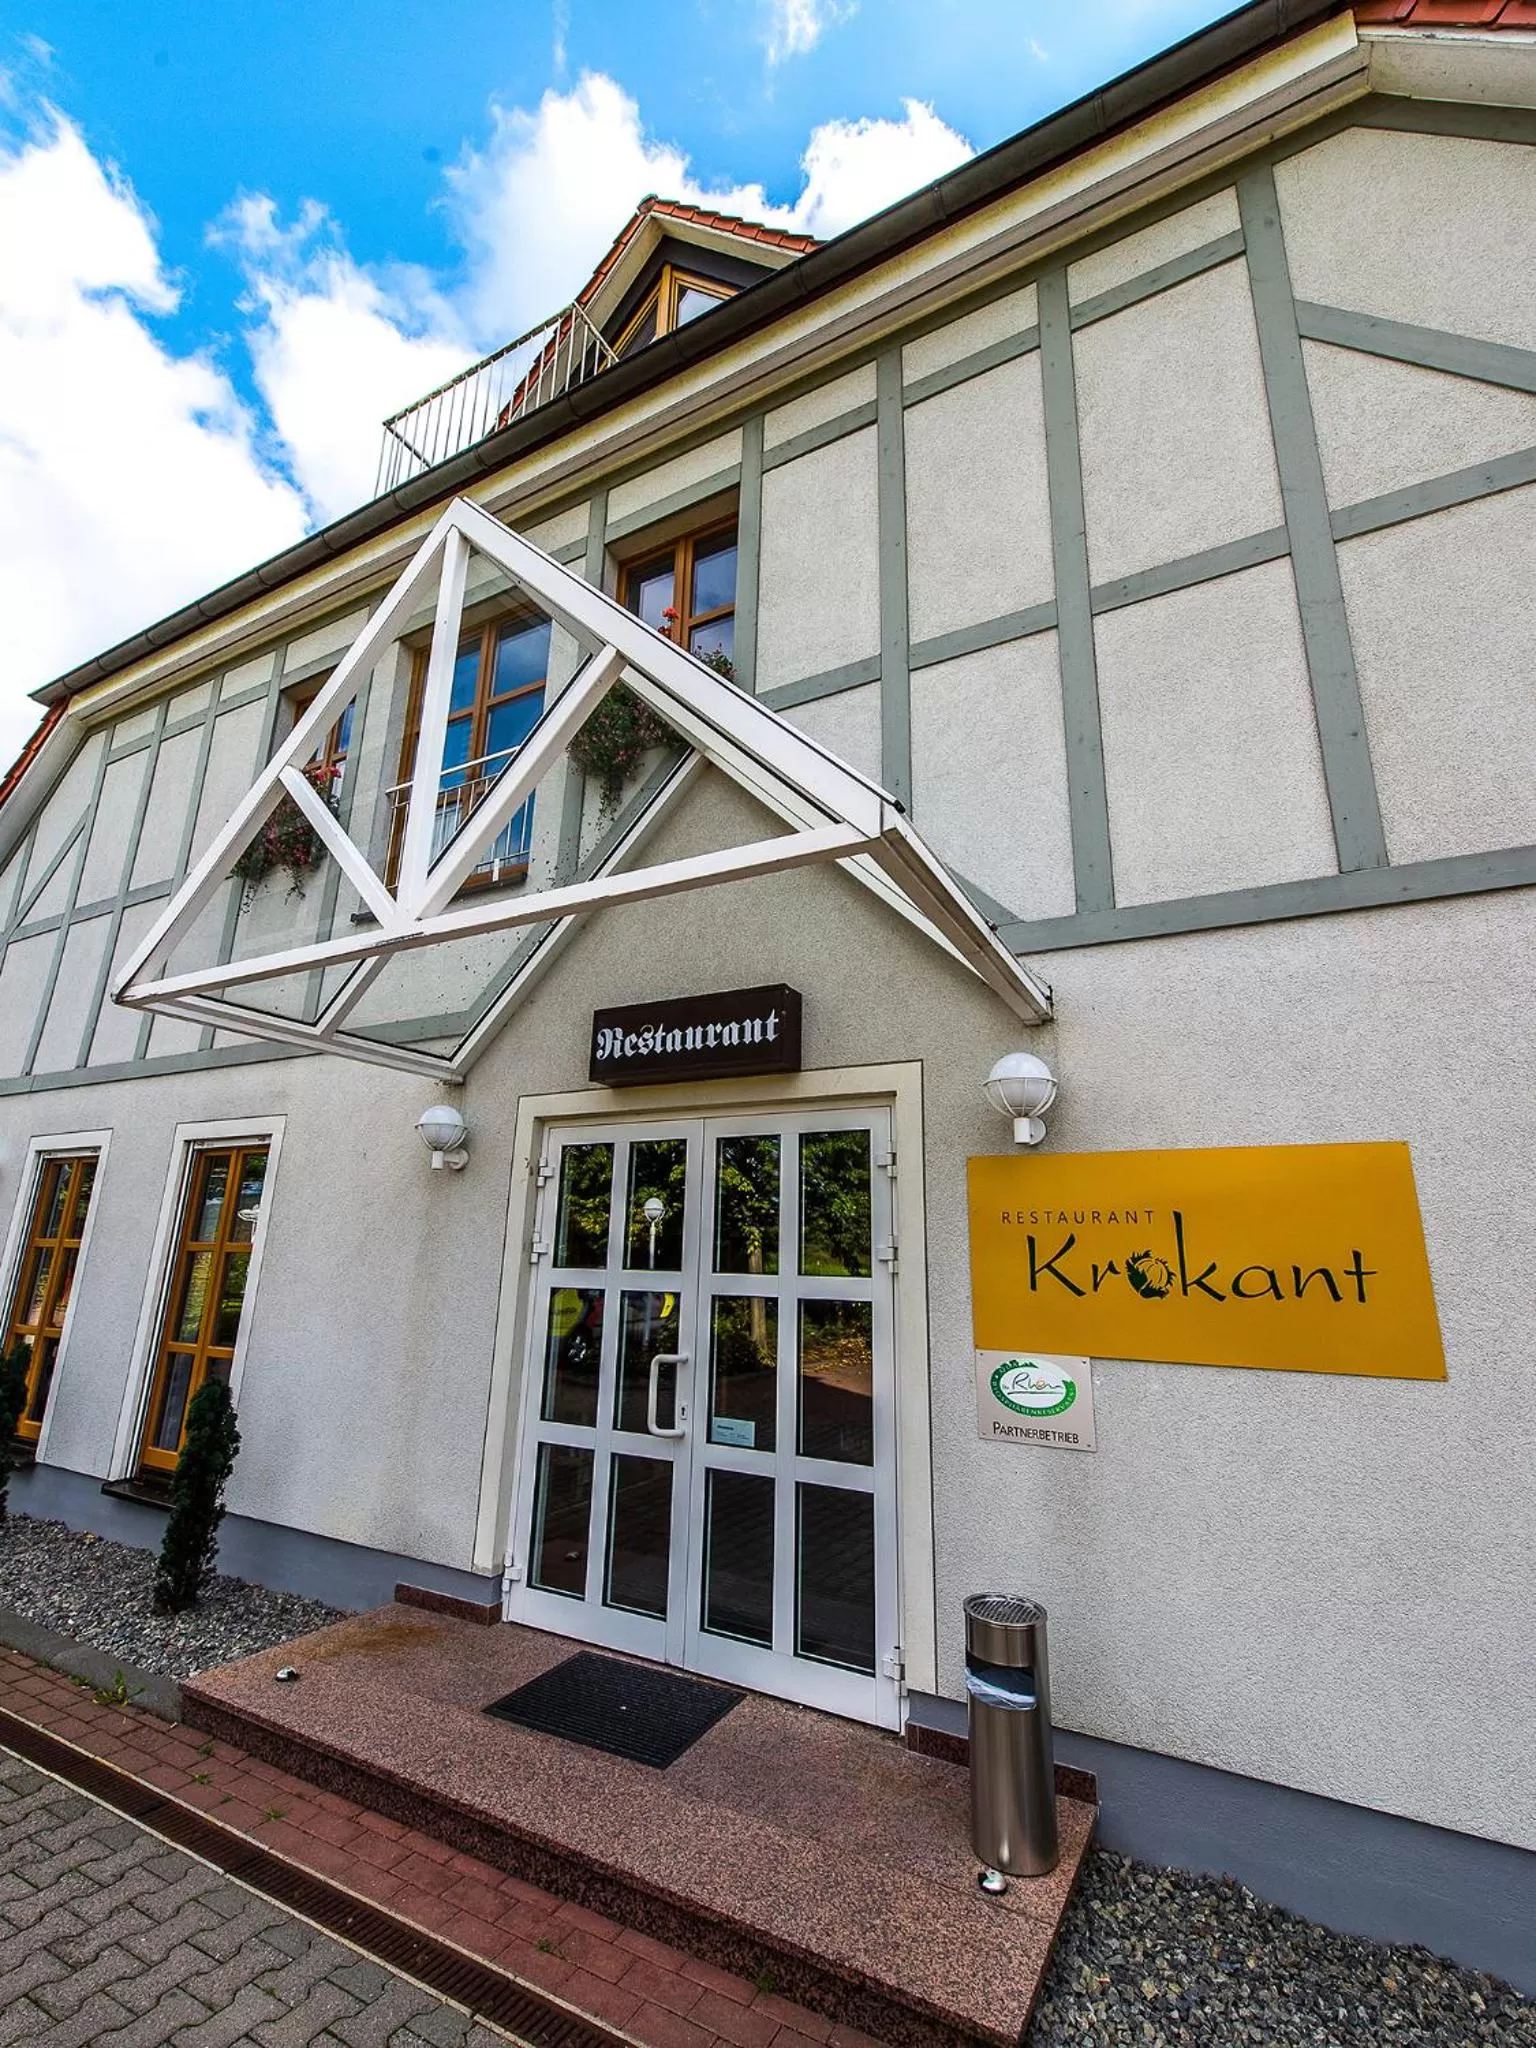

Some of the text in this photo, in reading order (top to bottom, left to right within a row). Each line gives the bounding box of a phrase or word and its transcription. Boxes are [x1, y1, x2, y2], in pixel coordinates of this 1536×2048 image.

[596, 1008, 779, 1060] Restaurant
[1001, 1210, 1155, 1225] RESTAURANT
[1026, 1210, 1378, 1304] Krokant
